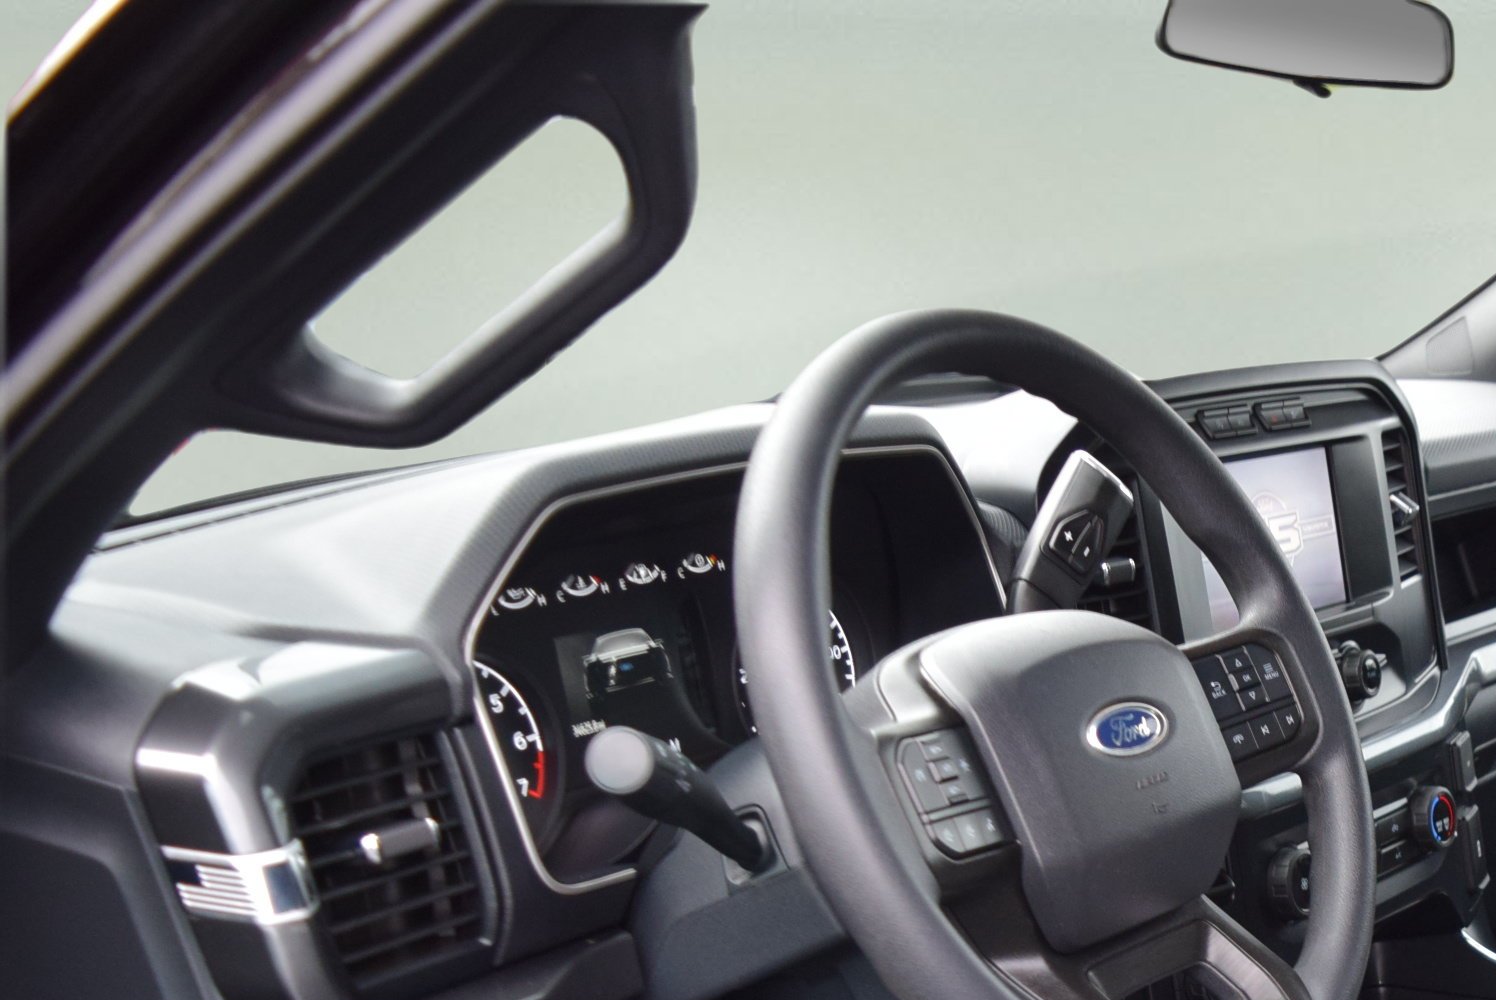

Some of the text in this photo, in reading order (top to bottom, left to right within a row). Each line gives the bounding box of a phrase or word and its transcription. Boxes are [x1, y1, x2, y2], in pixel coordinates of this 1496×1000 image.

[488, 692, 504, 714] 5
[1212, 688, 1227, 699] BACK
[512, 730, 528, 750] 6
[1109, 713, 1151, 747] Ford
[516, 777, 529, 797] 7
